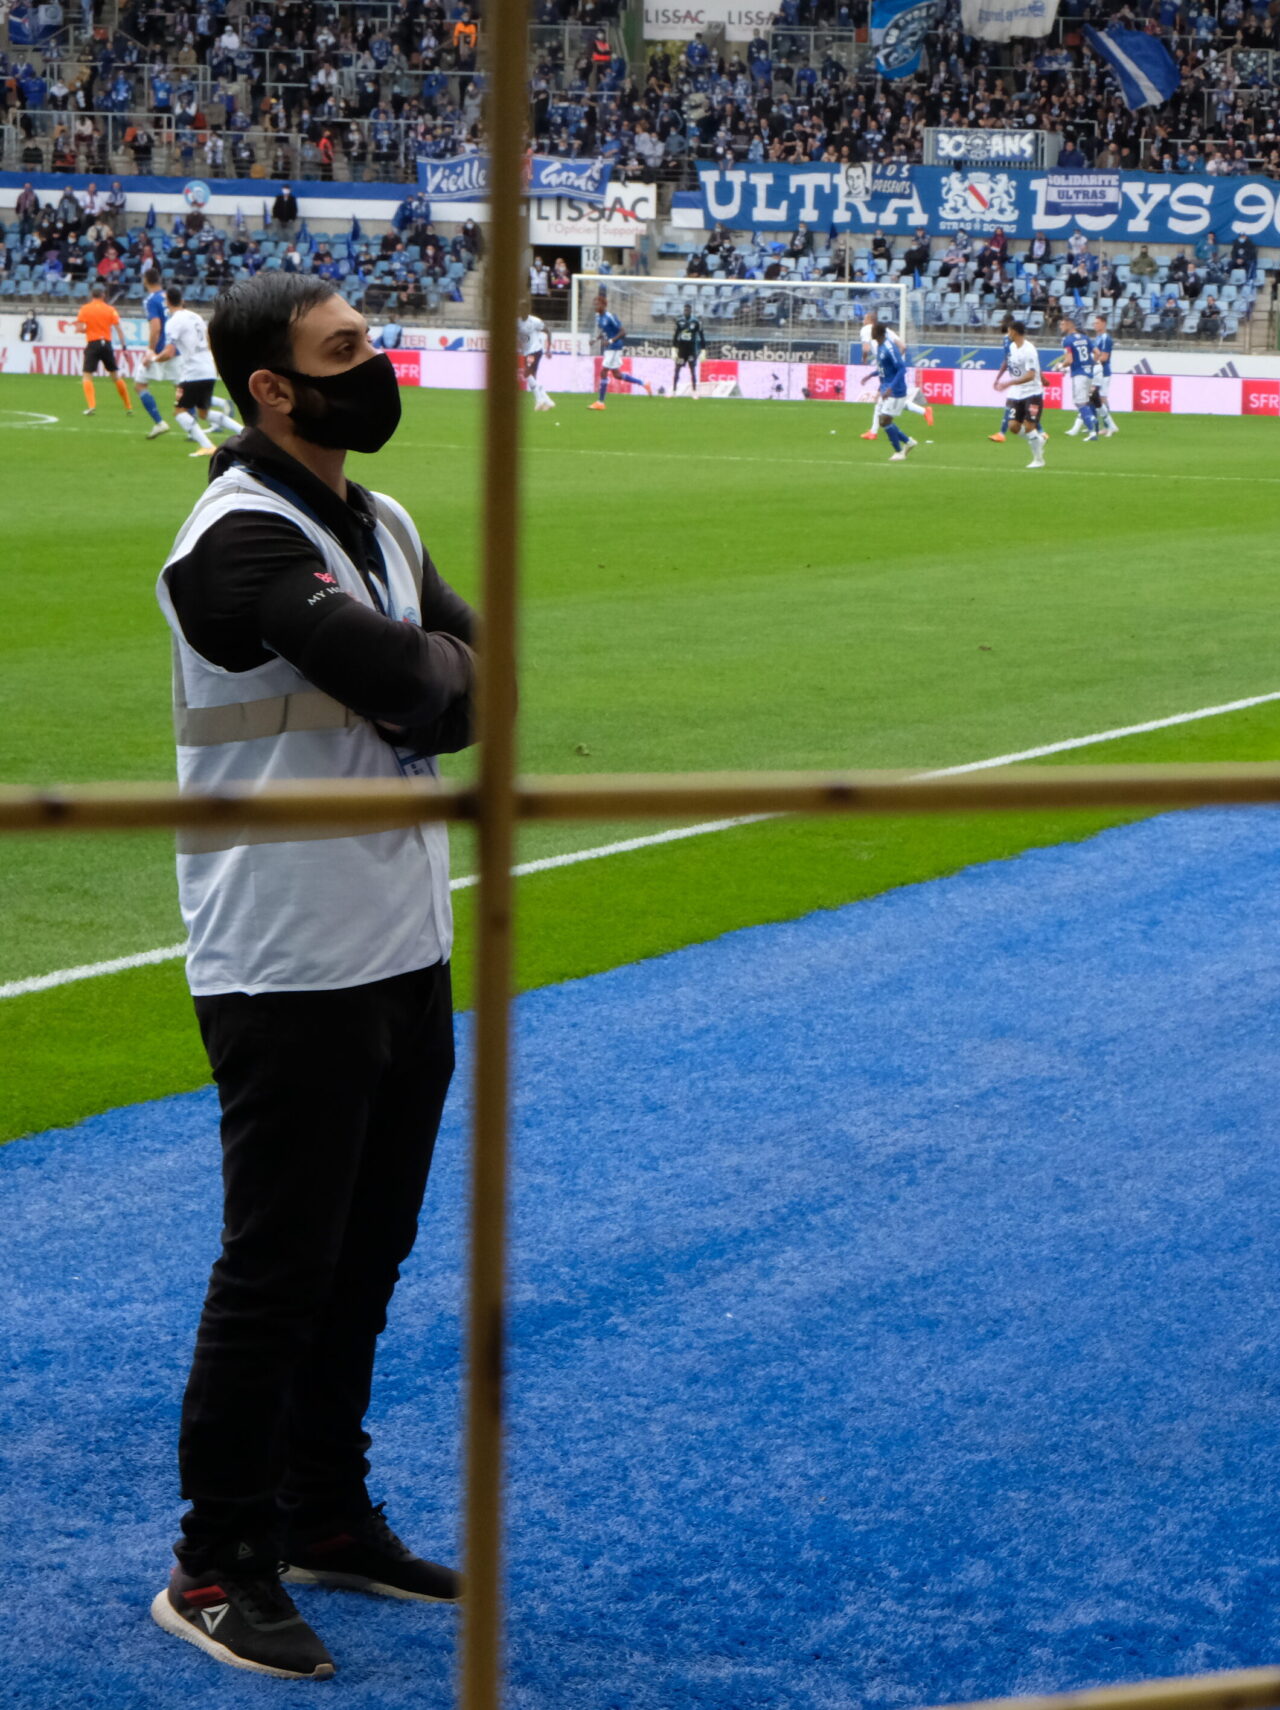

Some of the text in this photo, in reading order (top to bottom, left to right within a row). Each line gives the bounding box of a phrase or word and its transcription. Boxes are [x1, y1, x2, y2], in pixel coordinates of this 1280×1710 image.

[644, 9, 705, 24] LISSAC
[936, 132, 1035, 158] 30 ANS
[1057, 189, 1107, 200] ULTRAS
[721, 345, 813, 362] Strasbourg
[1076, 346, 1089, 362] 13
[923, 382, 953, 397] SFR
[1140, 389, 1171, 404] SFR
[1249, 393, 1280, 408] SFR
[307, 589, 326, 606] MY
